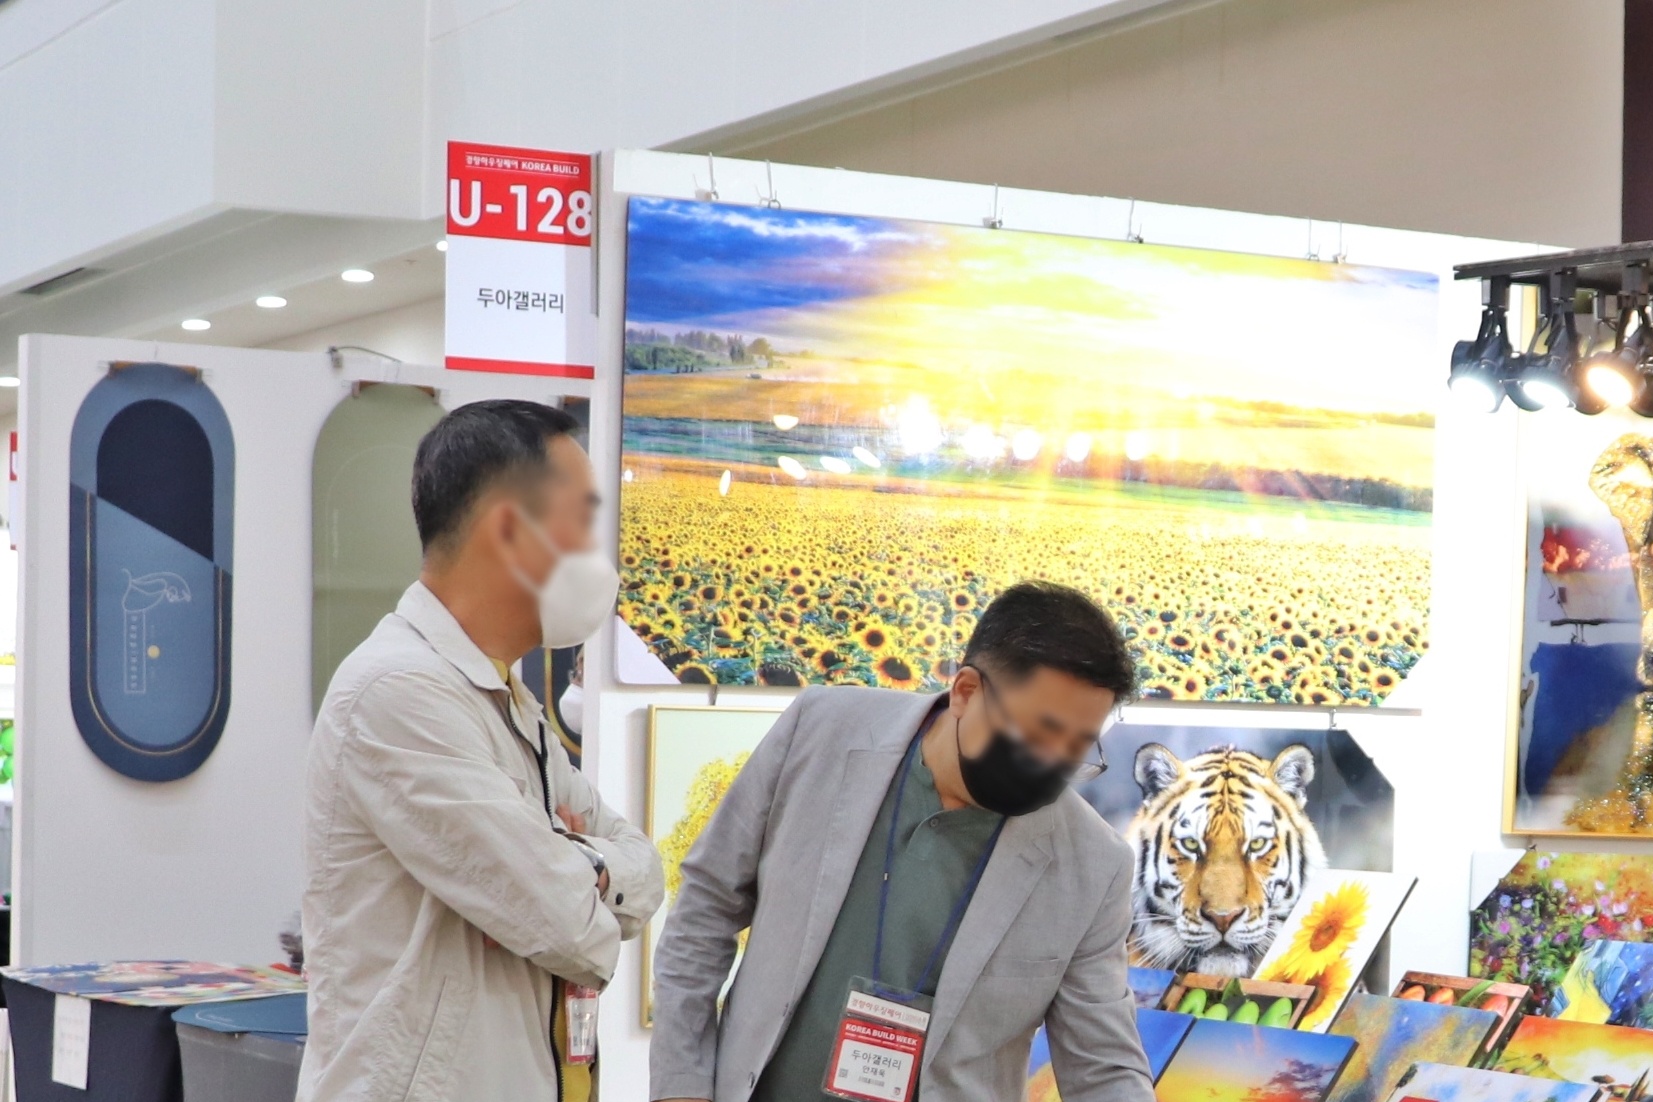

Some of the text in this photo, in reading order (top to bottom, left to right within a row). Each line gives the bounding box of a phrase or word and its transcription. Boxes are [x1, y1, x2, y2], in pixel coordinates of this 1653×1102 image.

[521, 161, 551, 172] KOREA
[552, 164, 580, 175] BUILD
[449, 178, 592, 238] U-128
[477, 288, 565, 314] 두아갤러리
[845, 1023, 918, 1046] KOREA BUILD WEEK
[851, 1049, 902, 1070] 두아갤러리
